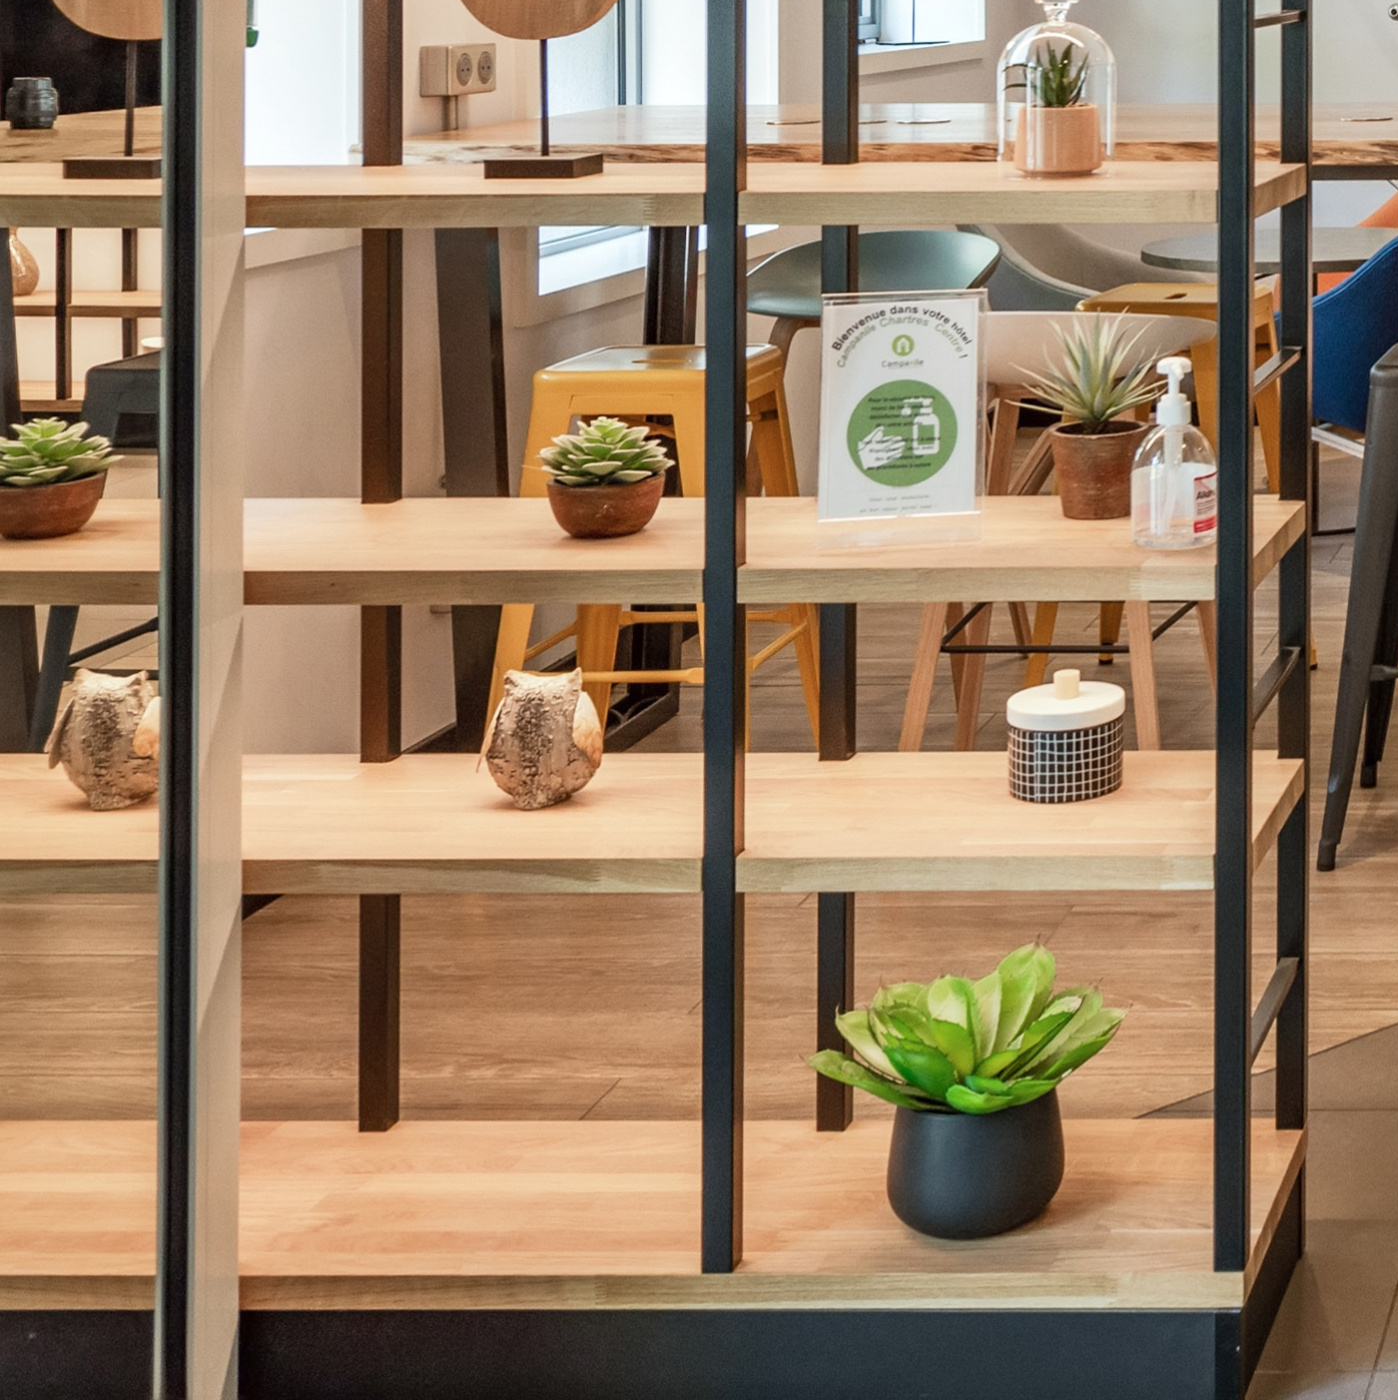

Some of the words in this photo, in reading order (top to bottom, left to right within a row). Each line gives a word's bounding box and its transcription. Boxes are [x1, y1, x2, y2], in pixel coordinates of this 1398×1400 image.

[832, 307, 886, 351] Bienvenue
[890, 305, 918, 315] dans
[923, 308, 950, 324] votre
[951, 322, 972, 345] hôtel
[879, 315, 929, 328] Chartres
[935, 323, 963, 353] Centre
